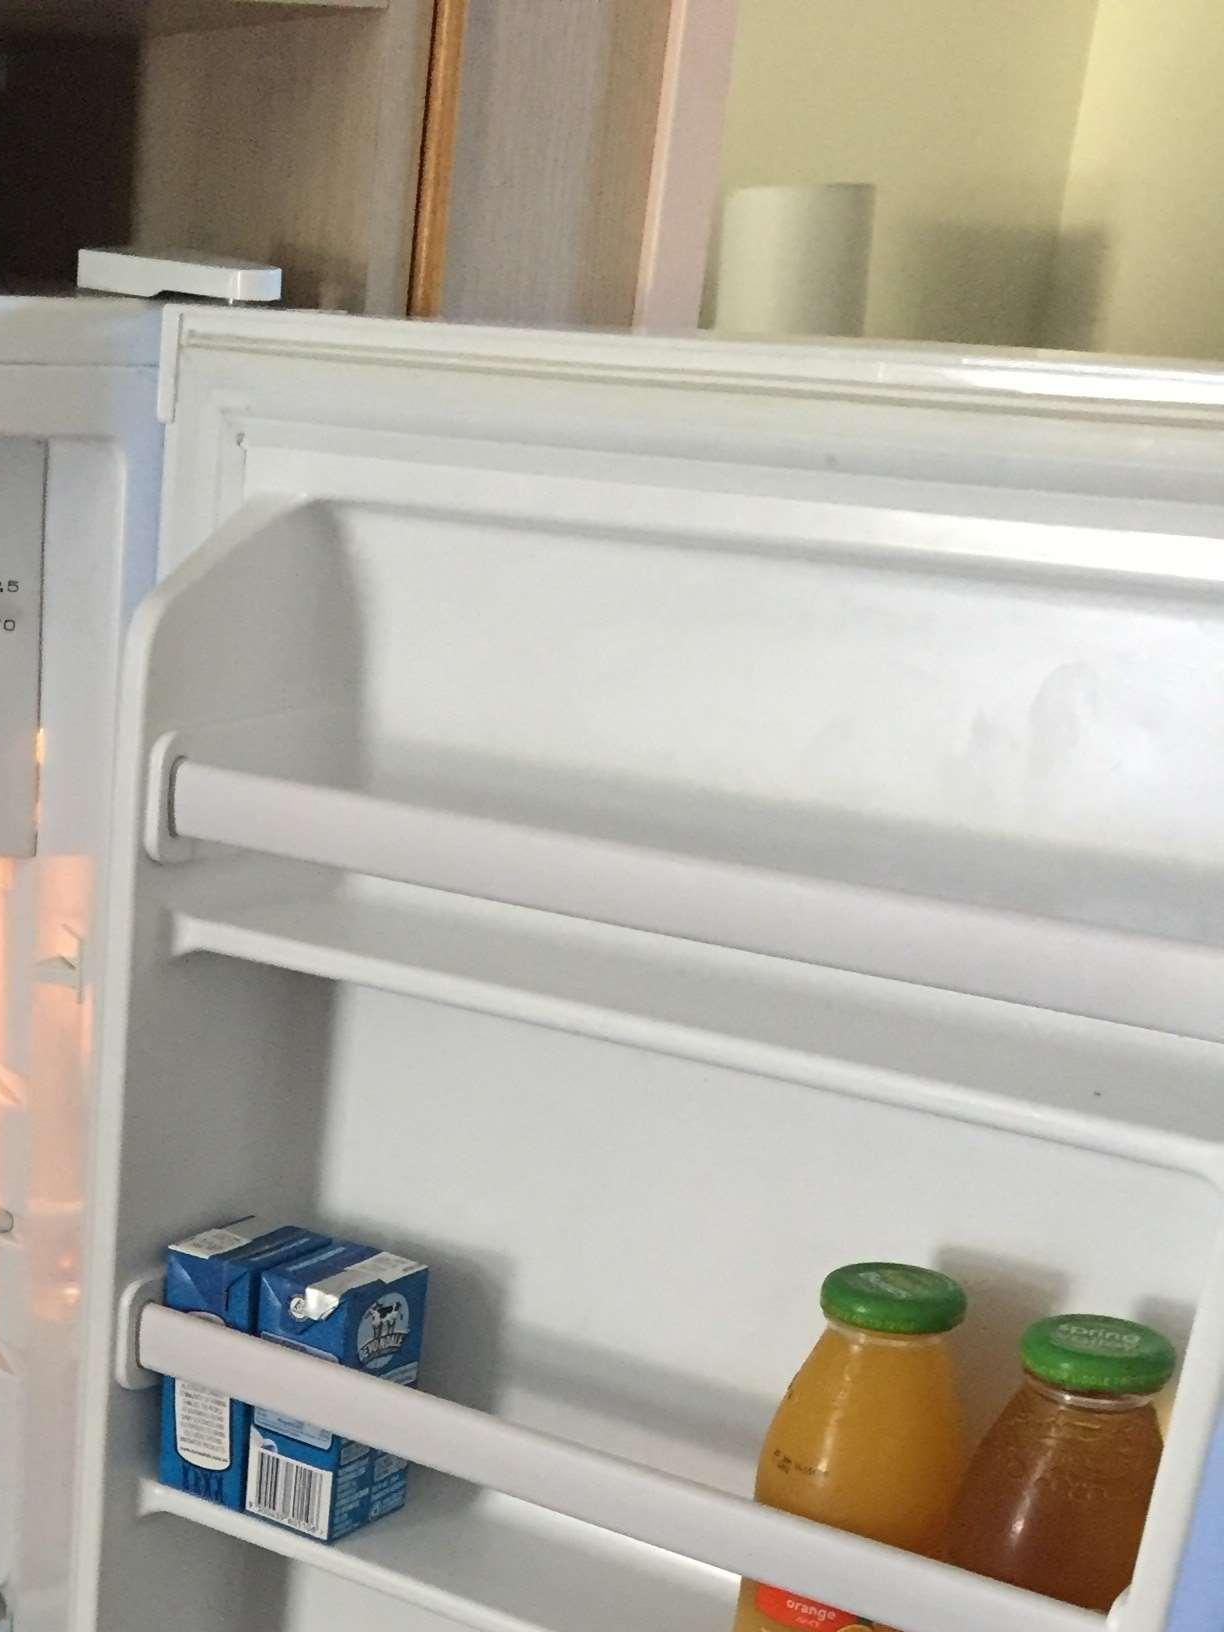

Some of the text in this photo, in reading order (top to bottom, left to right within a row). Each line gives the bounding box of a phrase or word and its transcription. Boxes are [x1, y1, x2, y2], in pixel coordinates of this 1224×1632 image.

[7, 580, 20, 593] 5
[3, 619, 16, 632] 0
[786, 1599, 836, 1621] orange
